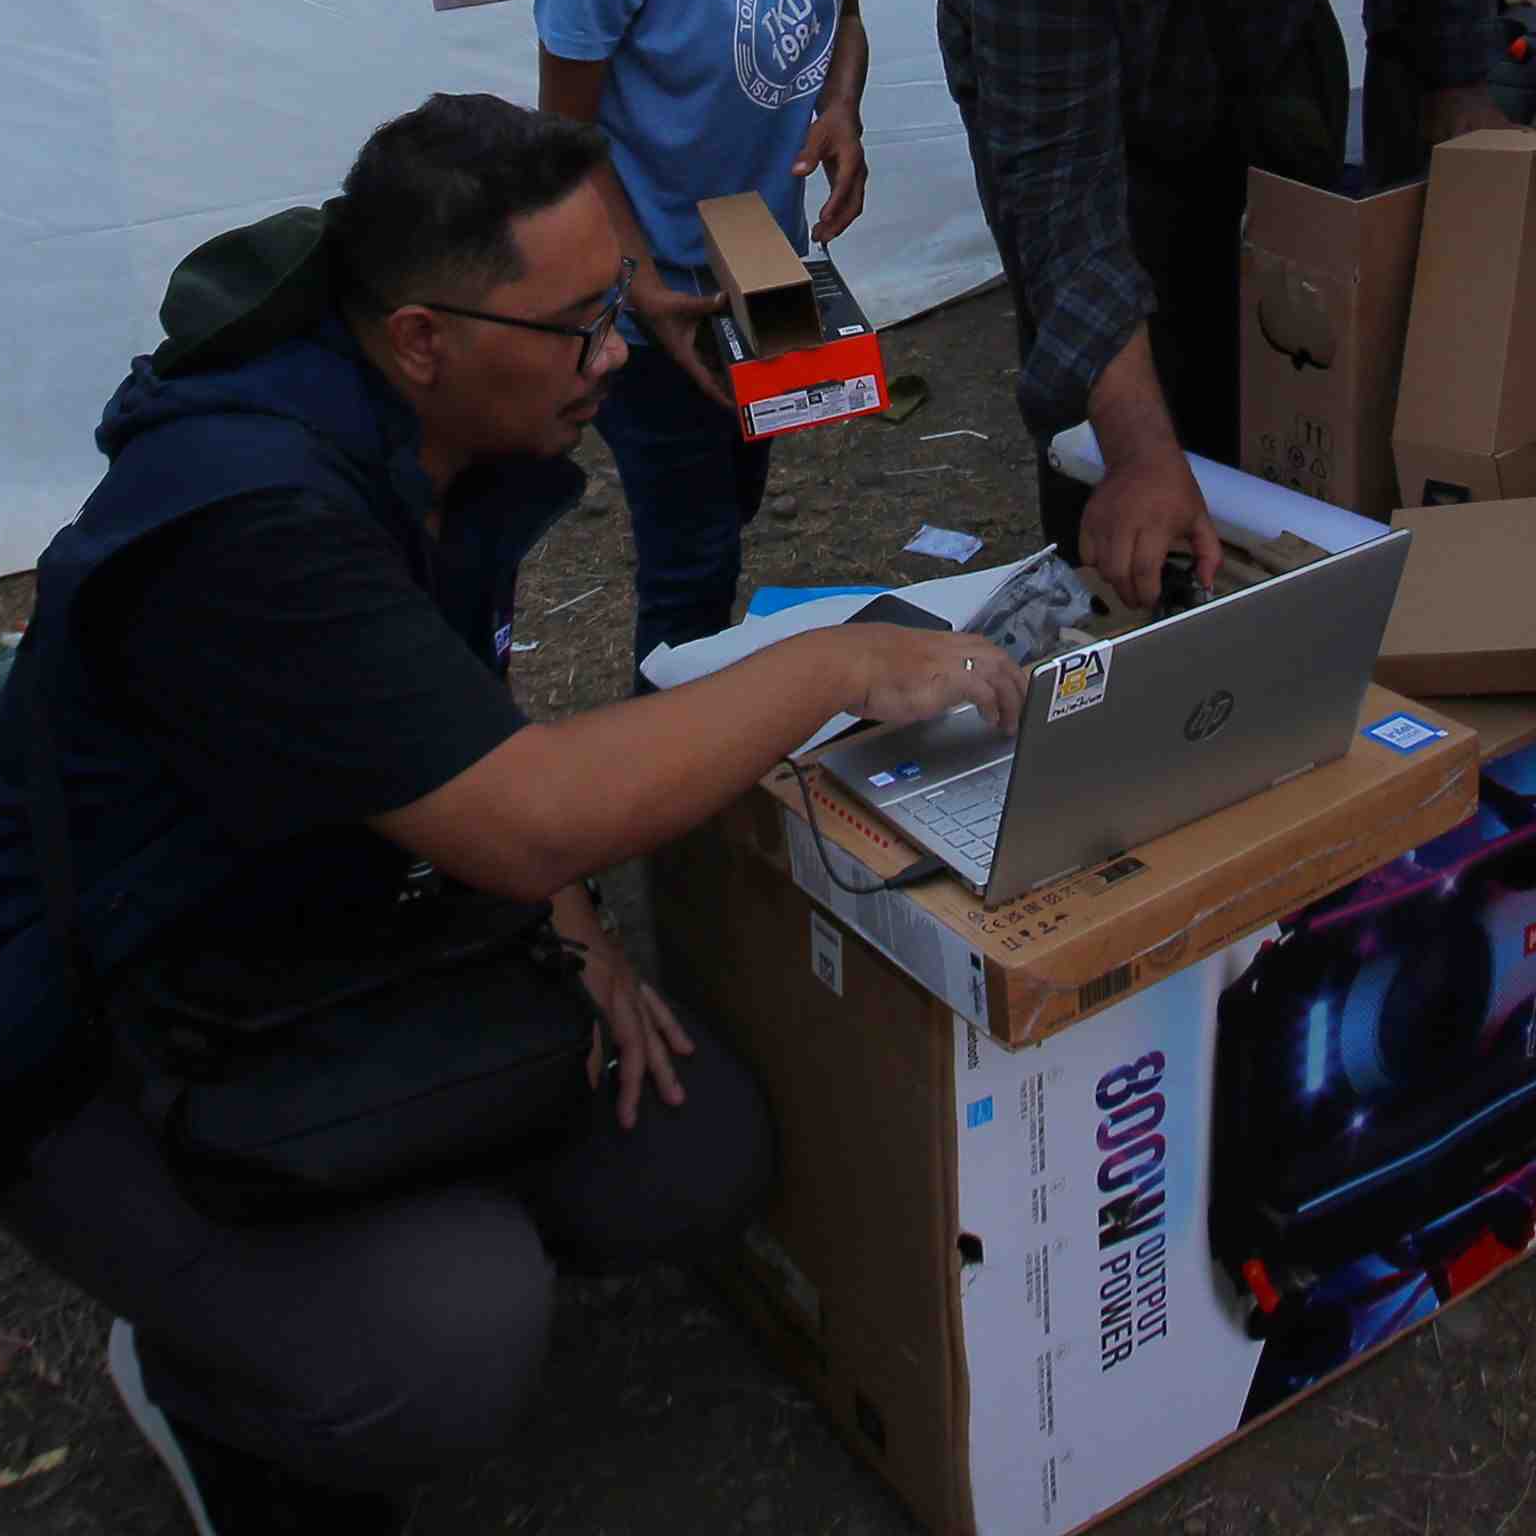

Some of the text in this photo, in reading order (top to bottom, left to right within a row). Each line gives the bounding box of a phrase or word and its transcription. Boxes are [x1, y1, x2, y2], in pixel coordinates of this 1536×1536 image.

[749, 50, 834, 105] ISLA CRE
[772, 13, 822, 71] 1984
[1095, 1050, 1166, 1250] 800W
[1099, 1248, 1133, 1374] POWER
[1136, 1232, 1167, 1346] OUTPUT
